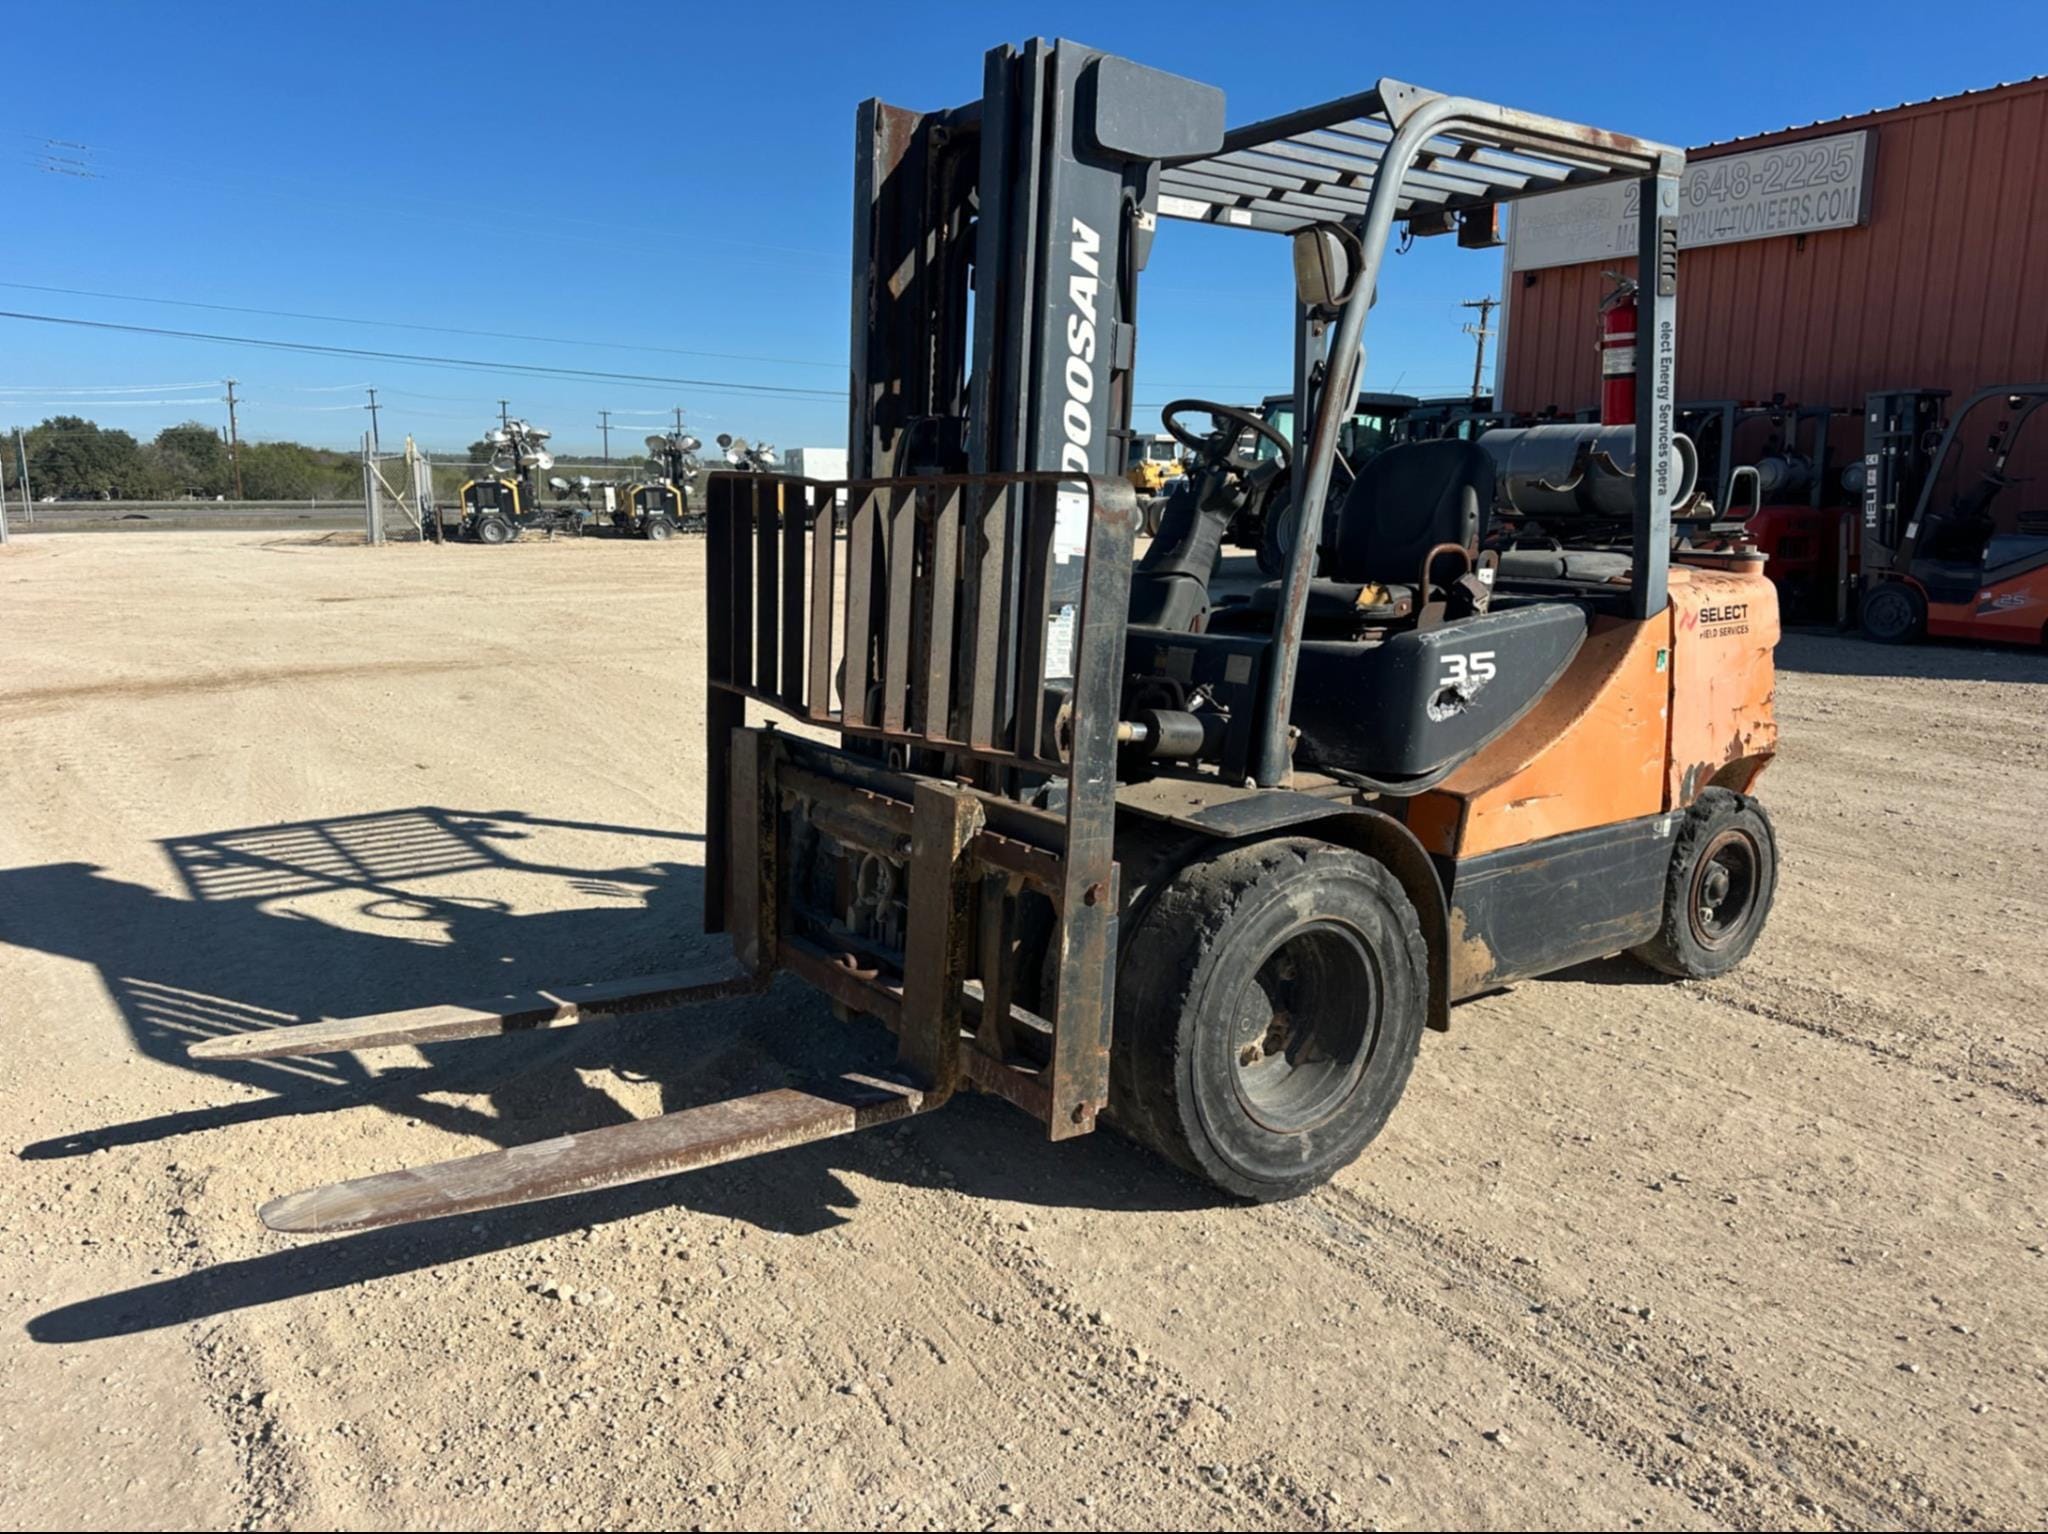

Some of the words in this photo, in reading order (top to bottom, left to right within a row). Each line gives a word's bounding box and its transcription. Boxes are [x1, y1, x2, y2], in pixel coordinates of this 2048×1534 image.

[1623, 141, 1854, 218] 2-648-2225
[1061, 217, 1100, 492] DOOSAN
[1657, 357, 1672, 400] Energy
[1658, 404, 1671, 458] Services
[1655, 461, 1668, 496] opera
[1866, 488, 1877, 528] HELI
[1700, 604, 1748, 623] SELECT
[1719, 625, 1749, 637] SERVICES
[1440, 651, 1496, 685] 35
